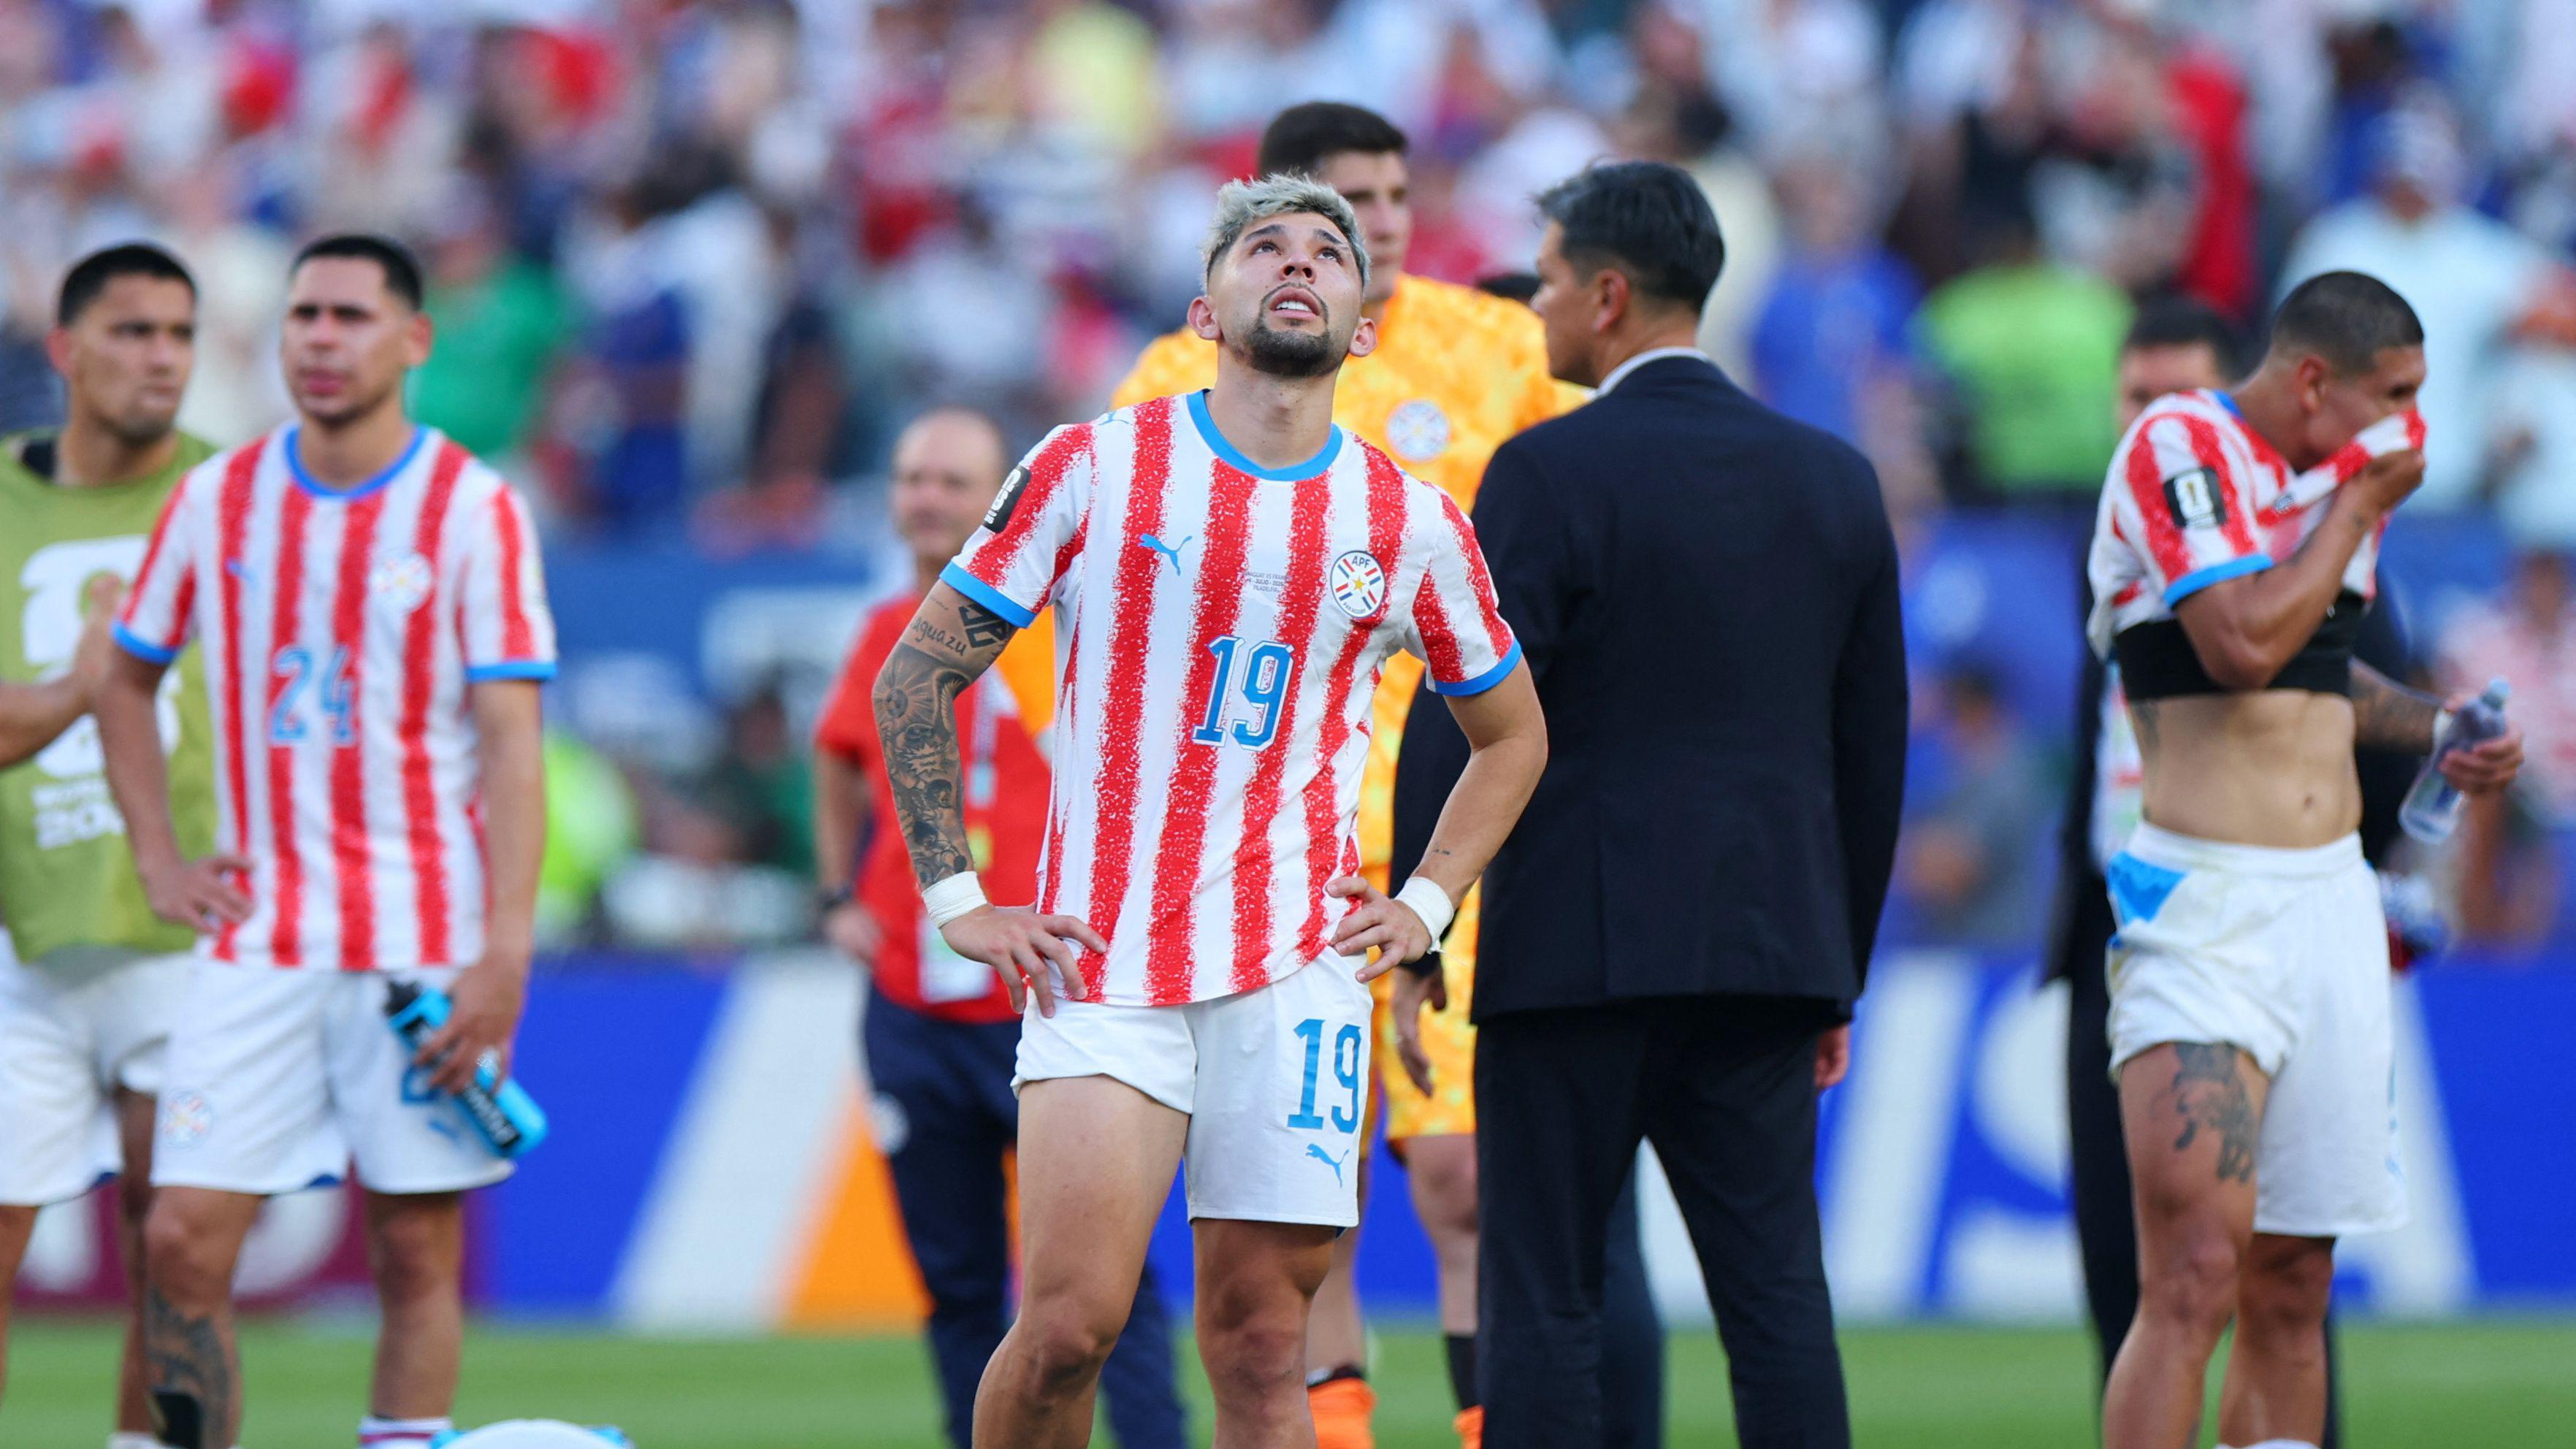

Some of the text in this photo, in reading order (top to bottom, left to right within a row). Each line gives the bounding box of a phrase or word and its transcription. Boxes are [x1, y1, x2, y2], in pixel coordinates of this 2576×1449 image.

[1351, 555, 1371, 568] APF
[270, 644, 355, 743] 24
[1191, 634, 1296, 752] 19
[1287, 1018, 1361, 1134] 19
